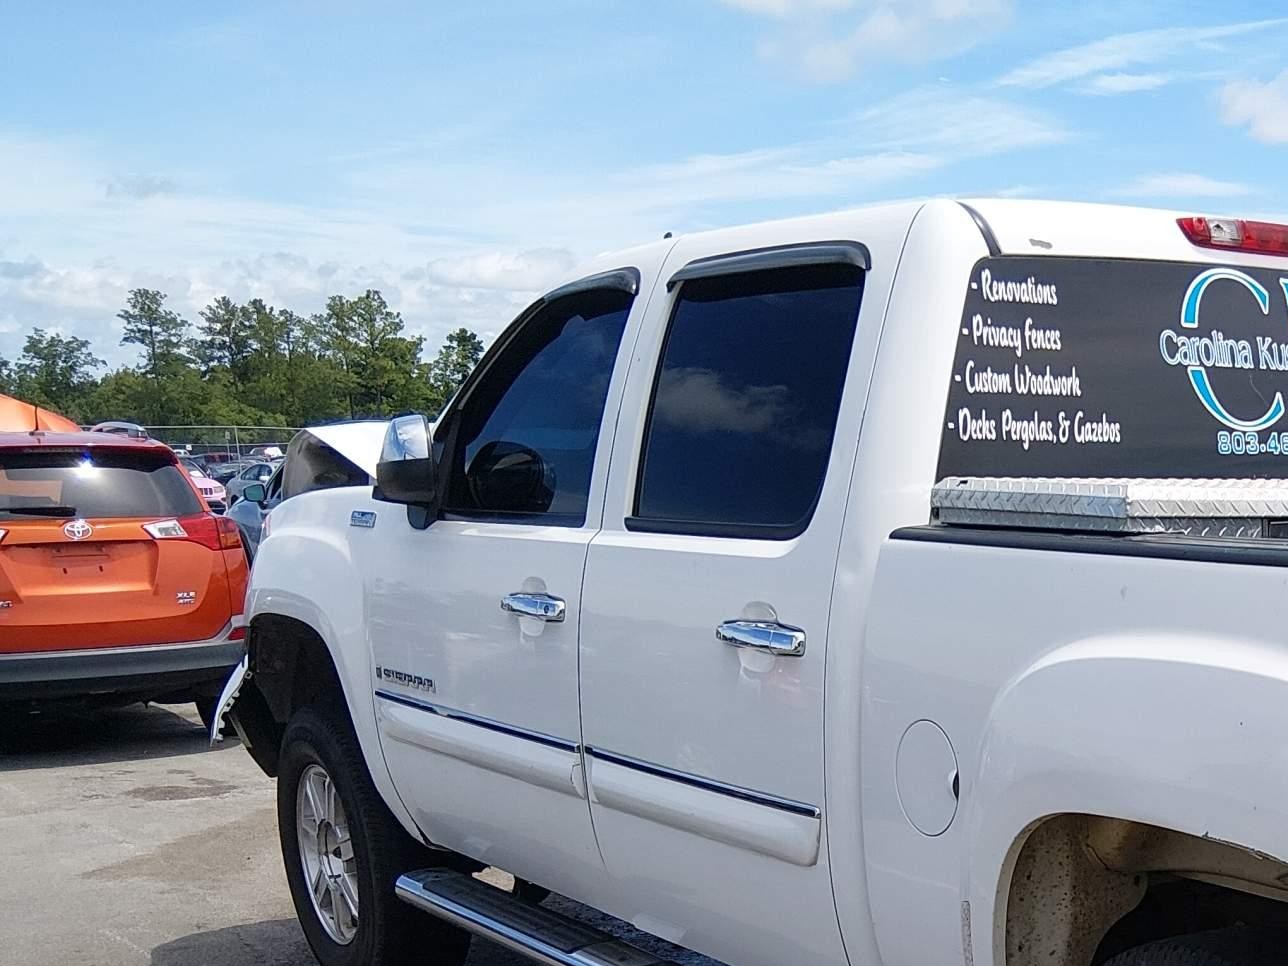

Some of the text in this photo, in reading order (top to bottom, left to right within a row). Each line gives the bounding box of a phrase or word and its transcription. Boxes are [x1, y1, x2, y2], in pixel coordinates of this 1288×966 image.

[981, 268, 1058, 305] Renovations
[972, 313, 1022, 357] Privacy
[1159, 329, 1254, 369] Carolina
[965, 360, 1012, 394] Custom
[1014, 364, 1082, 397] Woodwork
[958, 407, 997, 441] Decks
[1001, 409, 1057, 450] Pergolas,
[1058, 411, 1071, 443] &
[1073, 411, 1121, 444] Gazebos
